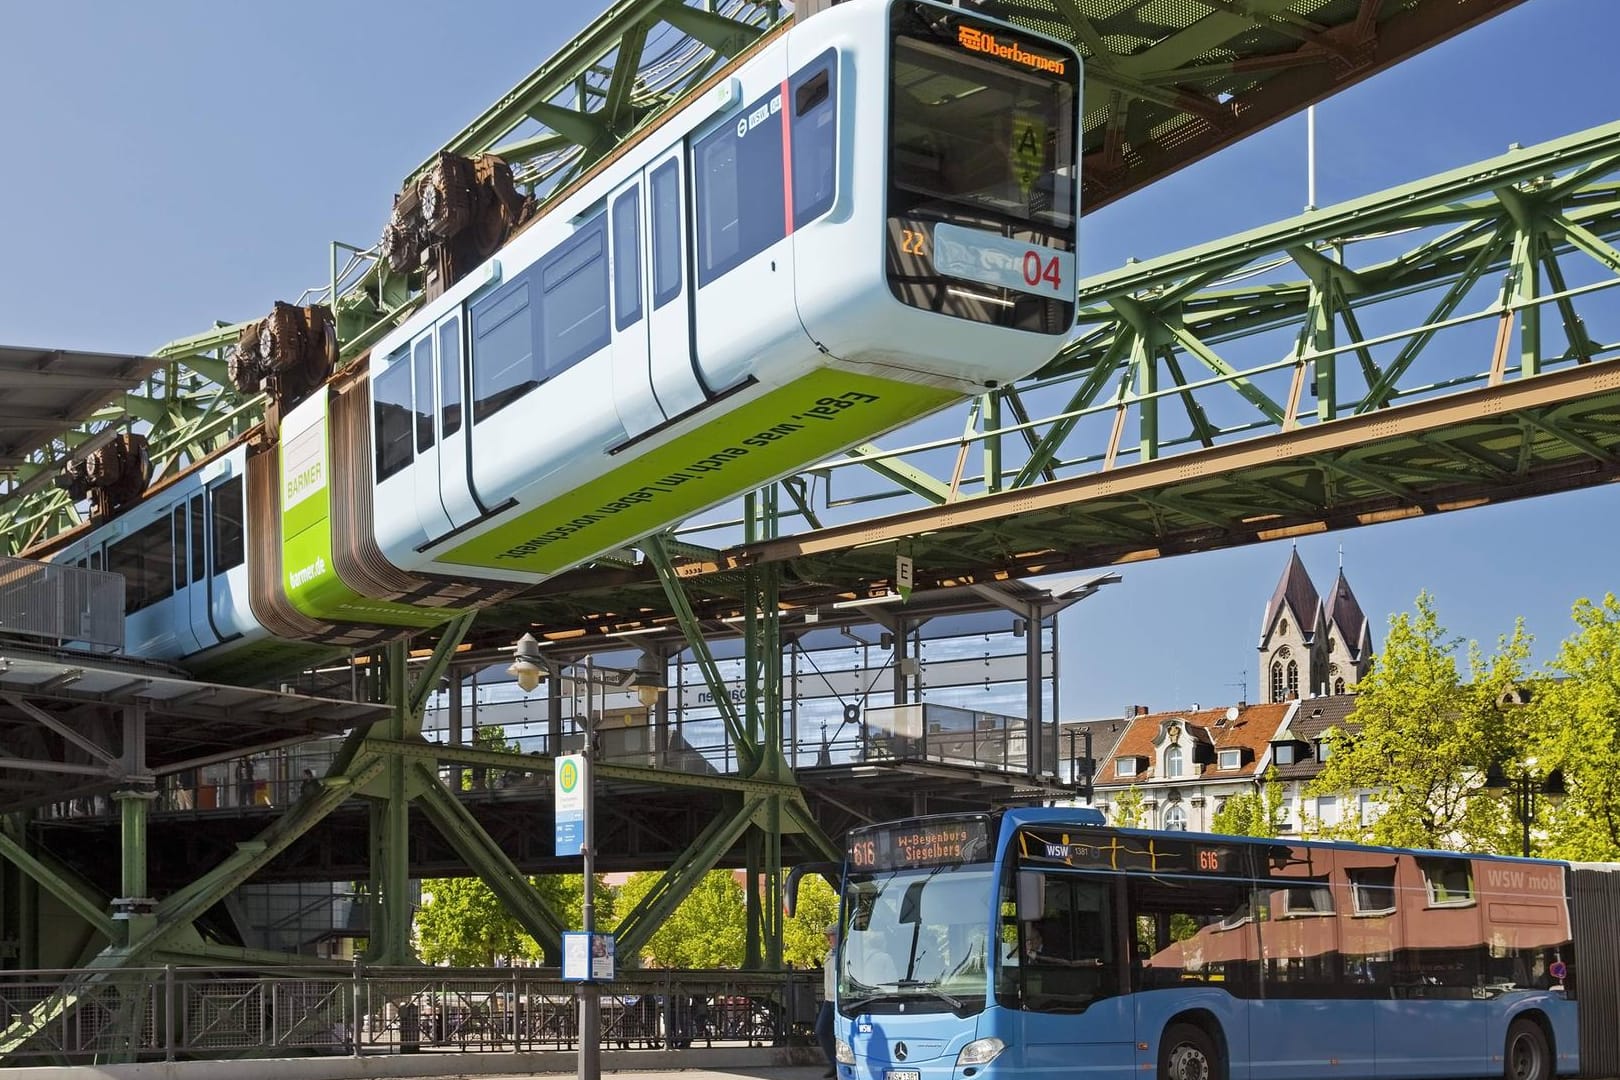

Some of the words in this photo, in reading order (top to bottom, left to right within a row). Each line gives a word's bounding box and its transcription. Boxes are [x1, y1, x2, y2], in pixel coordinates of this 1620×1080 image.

[980, 34, 1064, 75] Oberbarmen
[902, 229, 924, 256] 22
[1023, 250, 1061, 290] 04
[792, 391, 880, 421] Egal,
[742, 423, 804, 447] was
[685, 447, 749, 472] euch
[287, 462, 322, 499] BARMER
[656, 468, 704, 486] im
[602, 485, 672, 514] Leben
[289, 555, 326, 590] barmer.de
[901, 562, 909, 580] E
[854, 841, 875, 866] 616
[899, 831, 967, 848] W-Beyenburg
[906, 844, 961, 861] Siegelberg
[1046, 844, 1069, 857] WSW
[1074, 847, 1088, 856] 1381
[1200, 851, 1218, 870] 616
[1487, 869, 1524, 889] WSW
